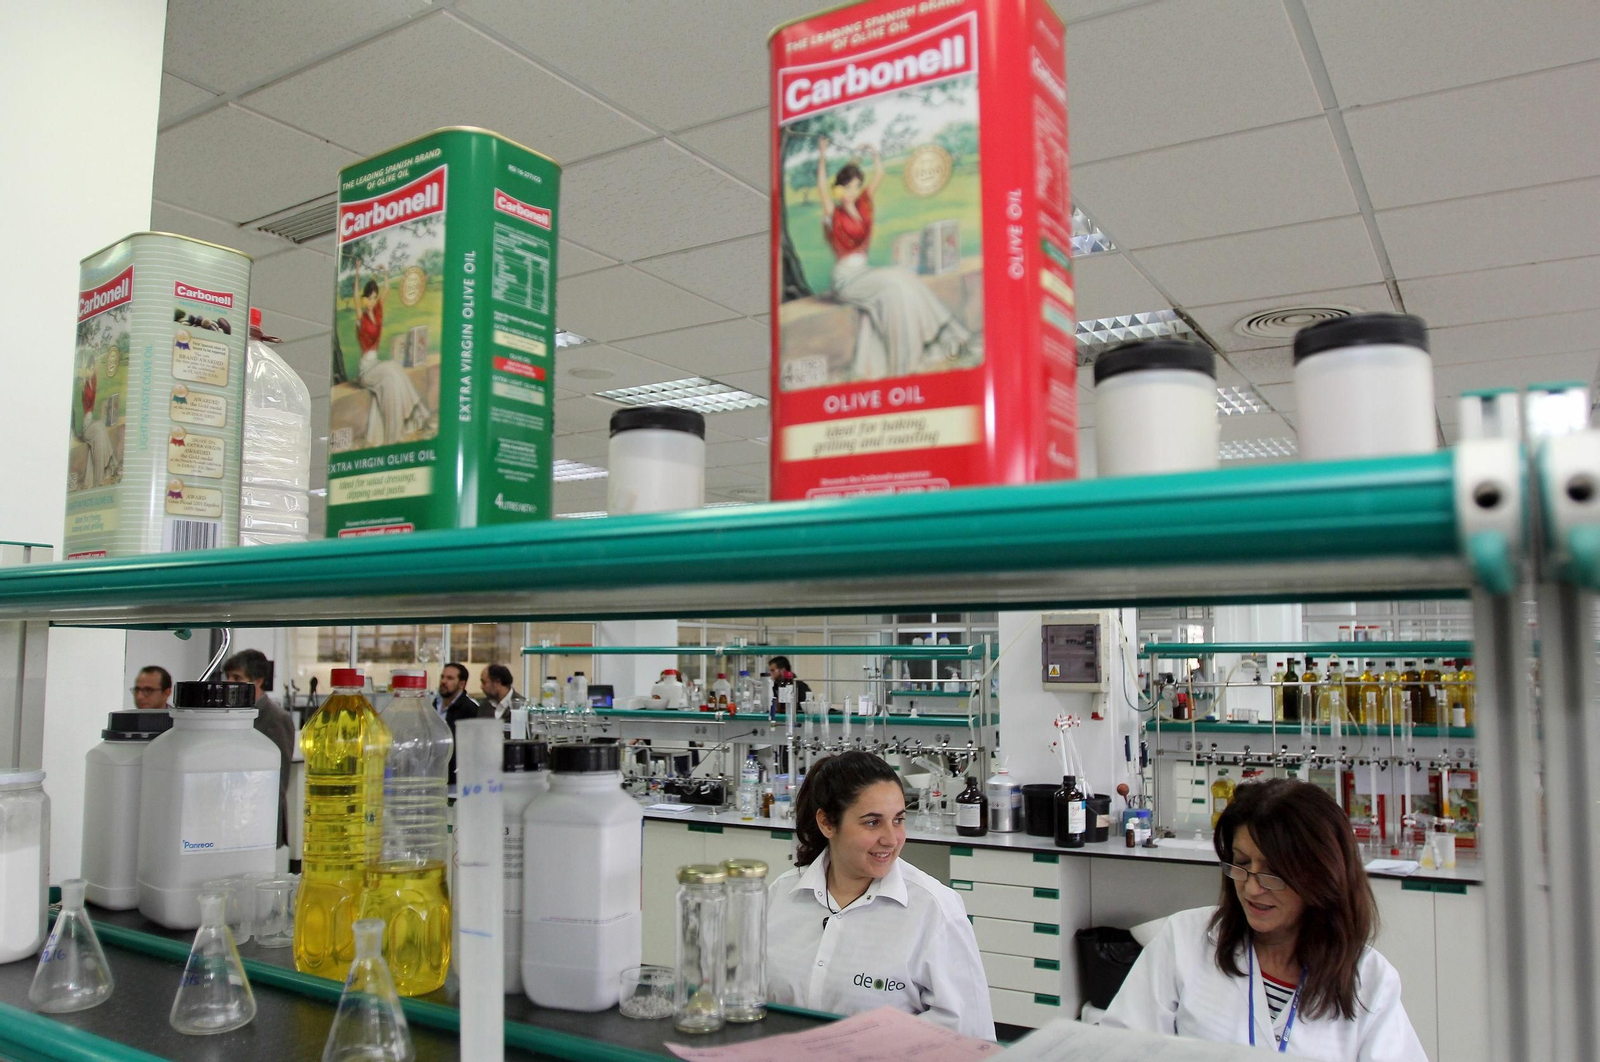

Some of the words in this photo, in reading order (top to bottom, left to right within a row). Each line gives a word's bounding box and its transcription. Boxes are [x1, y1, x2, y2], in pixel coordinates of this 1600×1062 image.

[786, 38, 807, 52] THE
[811, 21, 862, 44] LEADING
[864, 6, 916, 28] SPANISH
[832, 37, 847, 51] OF
[852, 26, 885, 44] OLIVE
[888, 19, 910, 34] OIL
[786, 34, 965, 111] Carbonell
[342, 180, 354, 190] THE
[356, 168, 383, 185] LEADING
[385, 158, 412, 174] SPANISH
[414, 148, 442, 162] BRAND
[367, 181, 376, 190] OF
[376, 173, 396, 186] OLIVE
[398, 169, 410, 179] OIL
[342, 182, 439, 236] Carbonell
[497, 196, 549, 225] Carbonell
[1006, 188, 1022, 220] OIL
[464, 250, 476, 274] OIL
[1007, 224, 1024, 280] OLIVE
[79, 278, 128, 317] Carbonell
[177, 285, 231, 306] Carbonell
[462, 278, 476, 319] OLIVE
[144, 344, 152, 358] OIL
[179, 353, 197, 361] BRAND
[199, 357, 223, 366] AWARDED
[460, 324, 474, 372] VIRGIN
[143, 360, 152, 386] OLIVE
[142, 387, 150, 412] TASTE
[193, 397, 219, 405] AWARDED
[459, 375, 472, 422] EXTRA
[823, 390, 882, 414] OLIVE
[888, 385, 926, 406] OIL
[142, 414, 149, 422] IN
[858, 421, 876, 436] for
[140, 426, 148, 450] LIGHT
[812, 437, 857, 458] grilling
[860, 434, 884, 448] and
[887, 430, 940, 447] roasting
[328, 462, 352, 474] EXTRA
[354, 457, 384, 469] VIRGIN
[387, 452, 414, 466] OLIVE
[418, 449, 436, 461] OIL
[347, 489, 371, 500] dipping
[372, 488, 385, 496] and
[386, 486, 405, 496] pasta
[354, 479, 364, 490] for
[366, 476, 384, 486] salad
[494, 492, 503, 508] 4
[184, 841, 214, 849] Panreac
